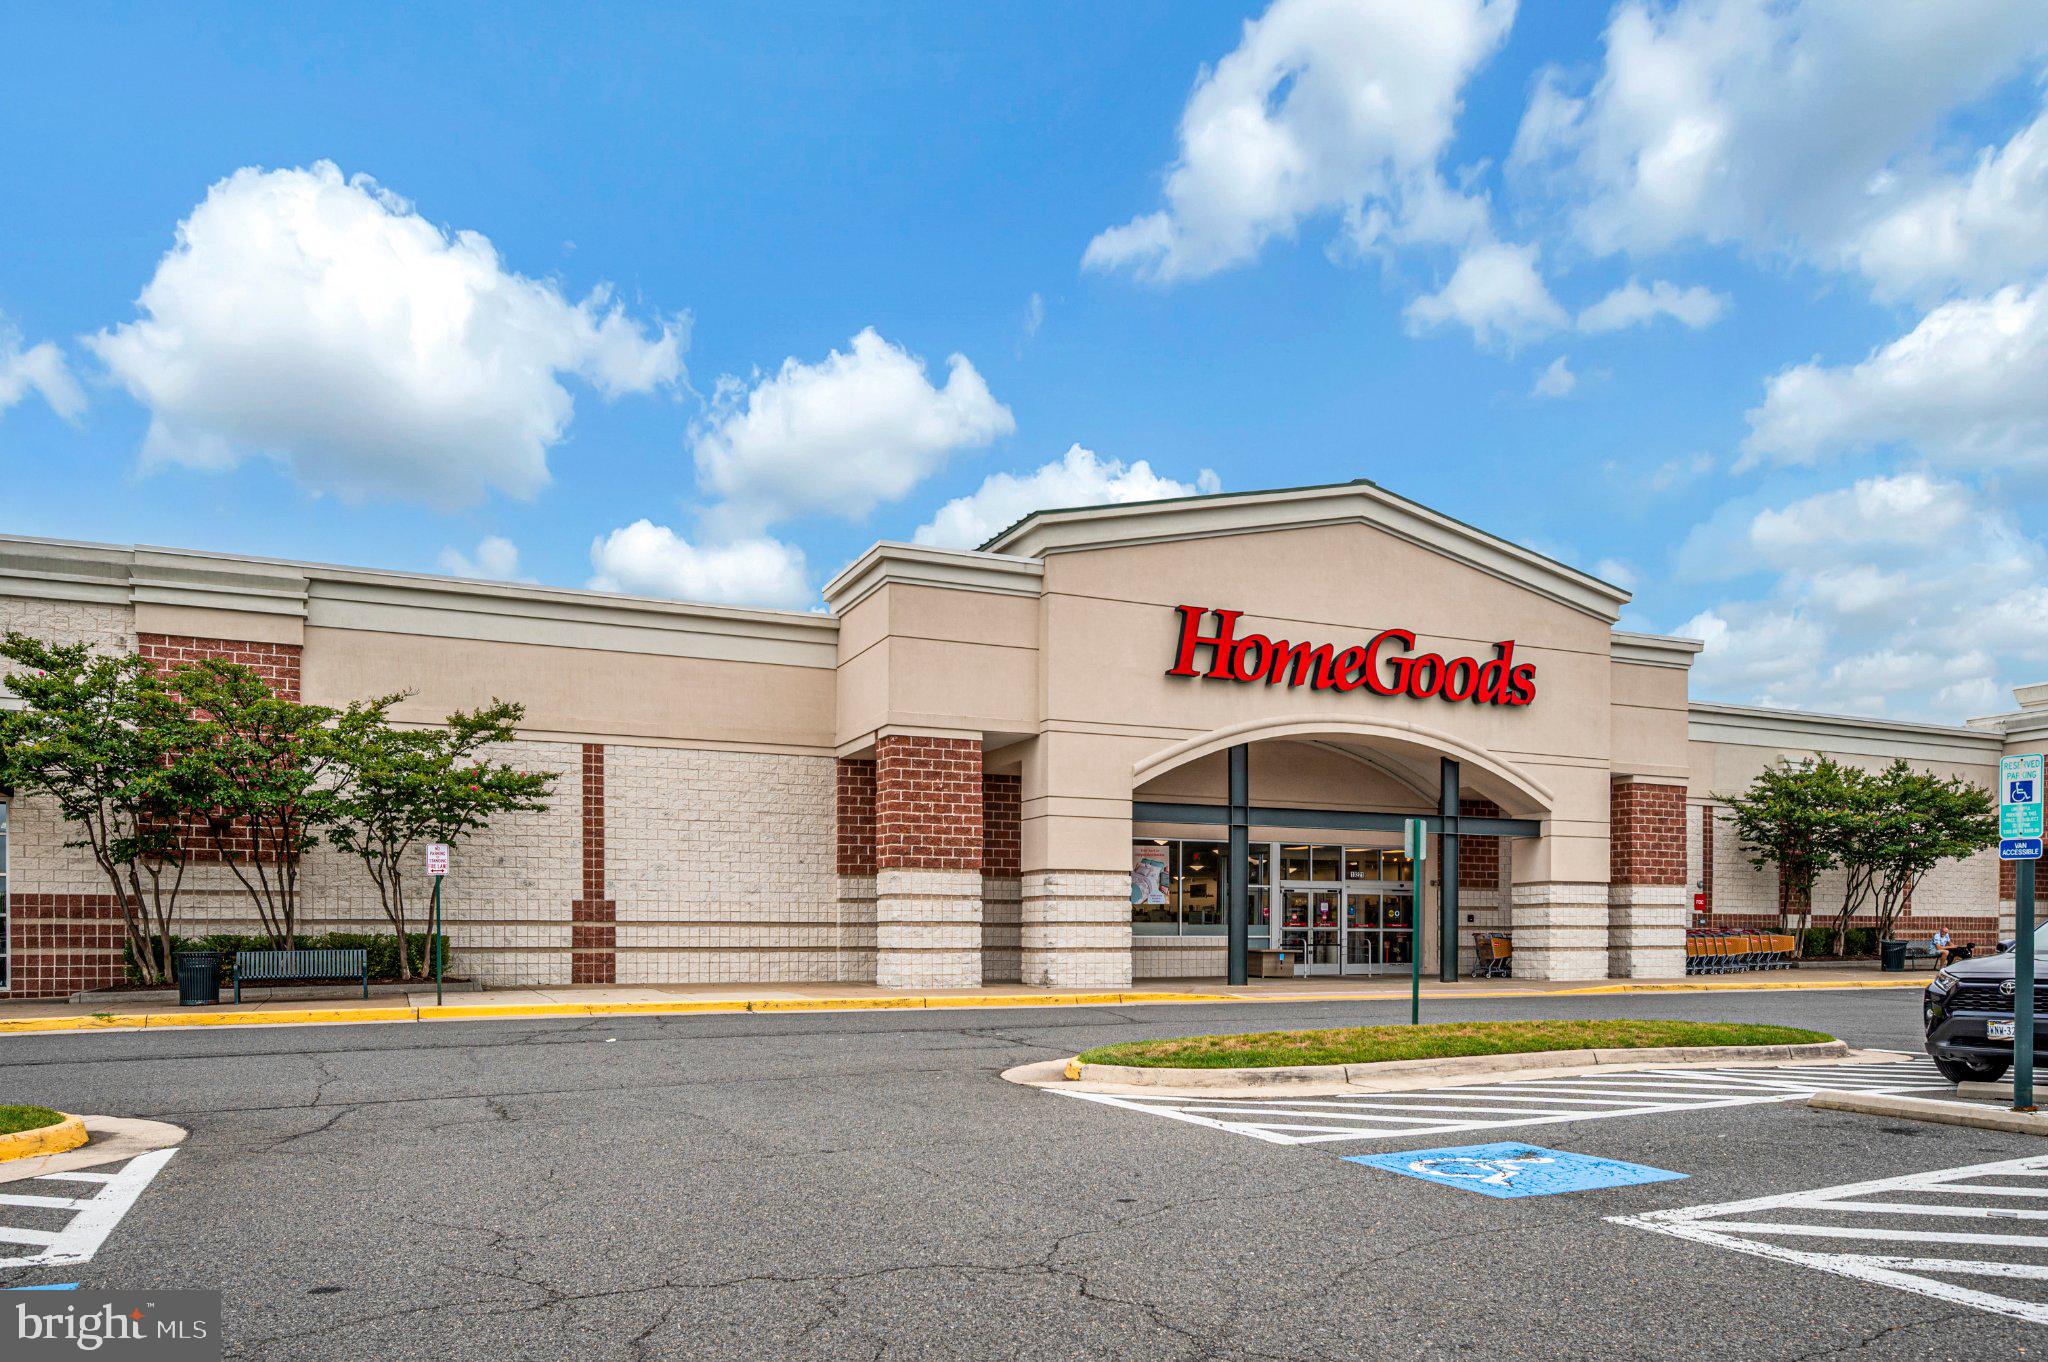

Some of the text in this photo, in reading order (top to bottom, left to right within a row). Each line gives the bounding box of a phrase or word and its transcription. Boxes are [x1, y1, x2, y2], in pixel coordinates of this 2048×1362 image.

[1165, 605, 1536, 705] HomeGoods
[2006, 771, 2037, 780] PARING
[2002, 848, 2039, 856] ACCESSIBLE
